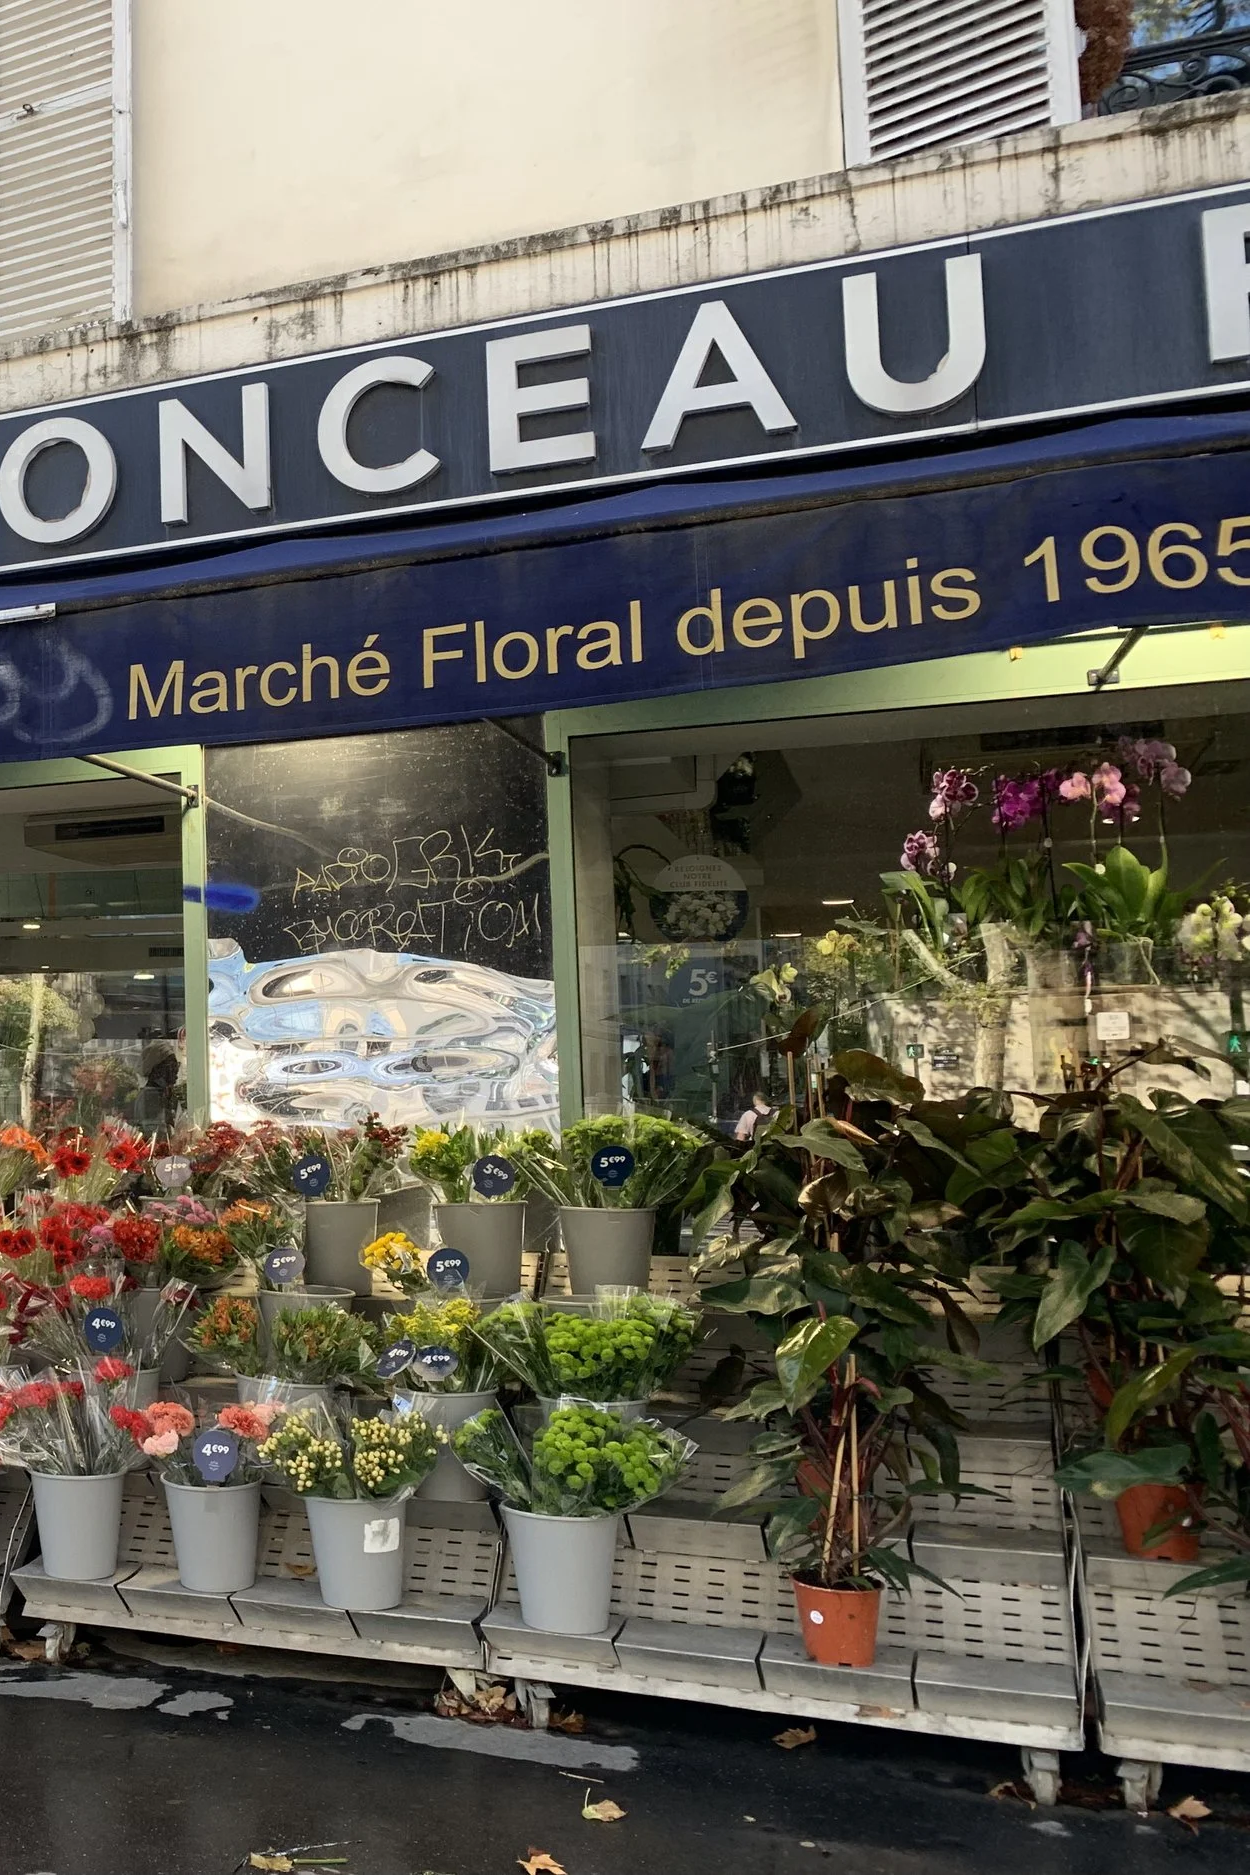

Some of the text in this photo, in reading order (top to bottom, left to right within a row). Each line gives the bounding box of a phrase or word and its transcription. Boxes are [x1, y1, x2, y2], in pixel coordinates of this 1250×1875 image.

[128, 634, 391, 721] Marché
[422, 600, 643, 690] Floral
[676, 558, 981, 660] depuis
[688, 968, 718, 996] 5€
[600, 1155, 626, 1168] 5€99
[300, 1163, 322, 1180] 5€99
[483, 1163, 509, 1180] 5€99
[272, 1255, 296, 1268] 5€99
[435, 1259, 462, 1273] 5€99
[92, 1317, 116, 1329] 4€99
[422, 1355, 450, 1365] 4€99
[201, 1443, 230, 1457] 4€99
